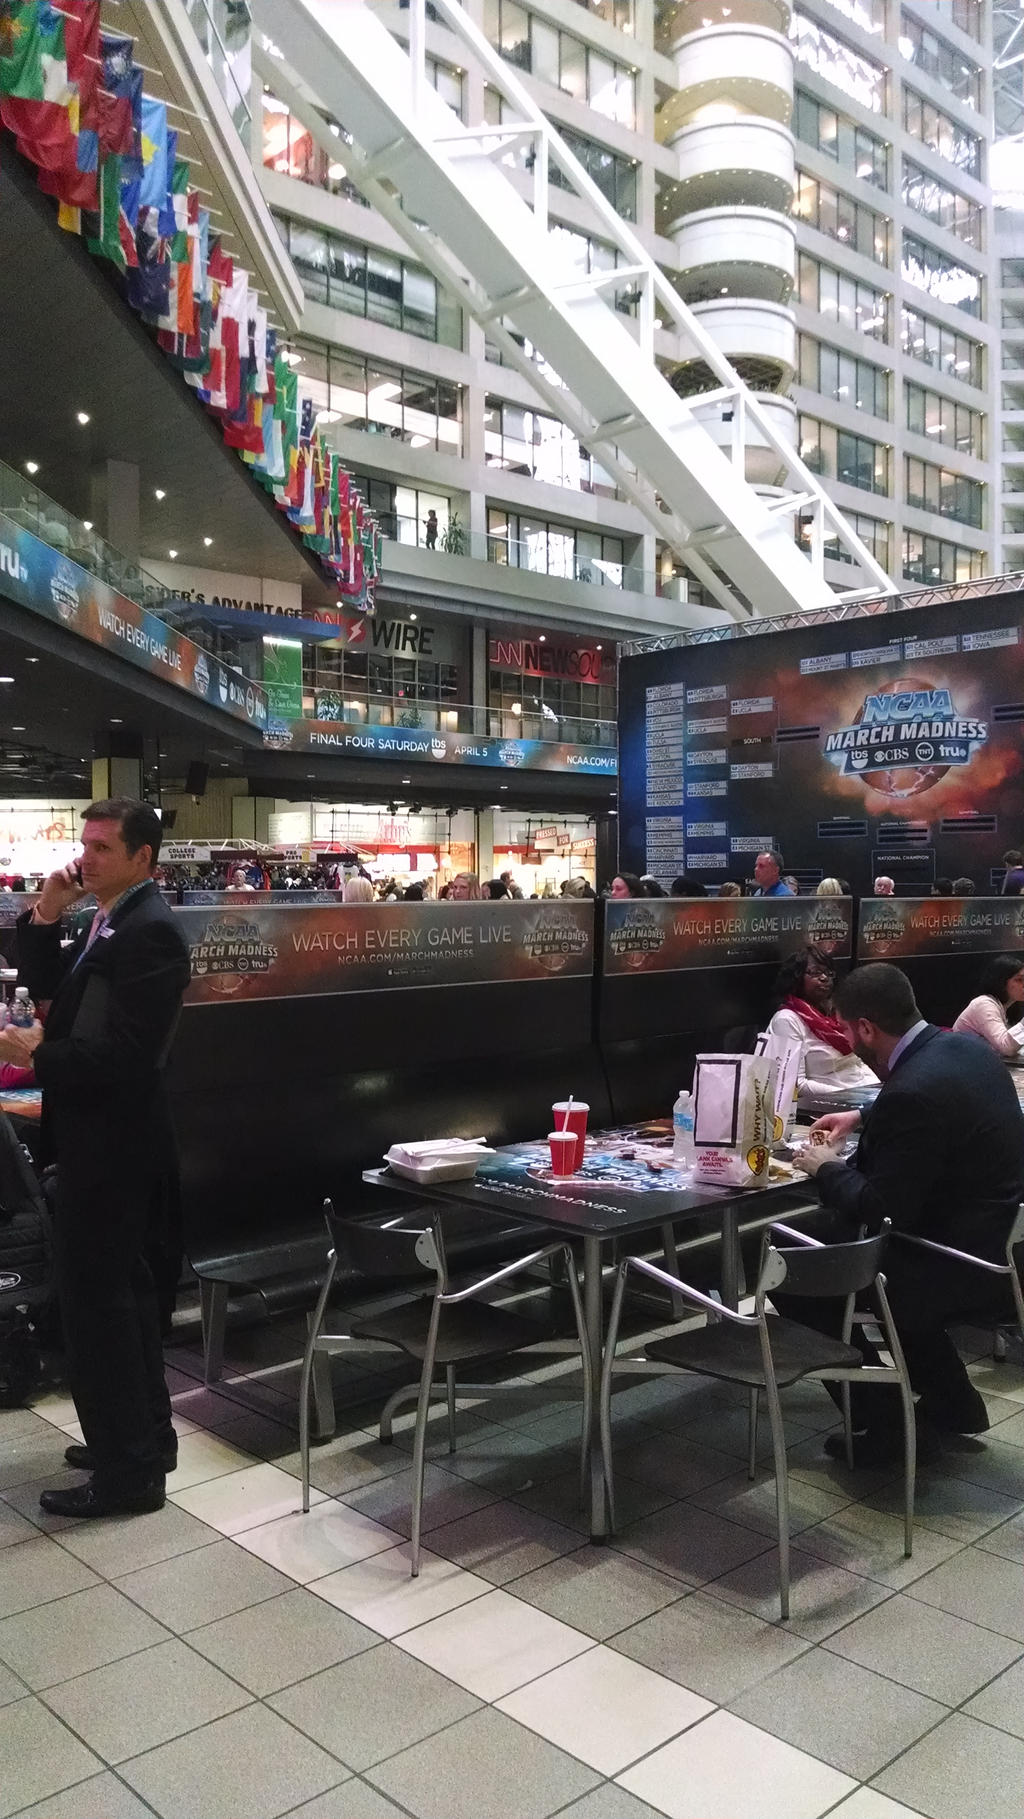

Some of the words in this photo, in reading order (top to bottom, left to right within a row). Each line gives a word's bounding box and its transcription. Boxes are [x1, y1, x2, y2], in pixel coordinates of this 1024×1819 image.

[98, 605, 126, 639] WATCH
[126, 622, 150, 652] EVERY
[149, 638, 168, 664] GAME
[168, 648, 182, 671] LIVE
[371, 617, 435, 655] WIRE
[972, 641, 991, 649] IOWA
[809, 656, 832, 665] ALBANY
[863, 688, 955, 723] NCAA
[743, 737, 762, 745] SOUTH
[826, 725, 895, 751] MARCH
[899, 720, 988, 740] MADNESS
[310, 732, 343, 746] FINAL
[345, 735, 375, 749] FOUR
[378, 738, 429, 753] SATURDAY
[431, 737, 446, 749] tbs
[454, 745, 481, 756] APRIL
[482, 747, 488, 758] 5
[850, 749, 869, 760] tbs
[884, 747, 910, 762] CBS
[559, 836, 569, 845] FOR
[673, 919, 712, 936] WATCH
[714, 918, 748, 934] EVERY
[750, 917, 779, 932] GAME
[781, 916, 802, 931] LIVE
[910, 914, 940, 929] WATCH
[942, 914, 968, 928] EVERY
[970, 913, 993, 927] GAME
[993, 912, 1011, 926] LIVE
[204, 923, 261, 943] NCAA
[292, 931, 359, 953] WATCH
[365, 928, 422, 949] EVERY
[427, 926, 474, 946] GAME
[479, 924, 512, 944] LIVE
[523, 931, 553, 945] MARCH
[555, 929, 589, 943] MADNESS
[609, 929, 637, 942] MARCH
[637, 928, 666, 940] MADNESS
[190, 944, 225, 960] ARCH
[228, 944, 278, 958] MADNESS
[338, 949, 475, 966] NCAA.COM/MARCHMADNESS
[753, 1078, 762, 1114] WAIT?
[753, 1115, 762, 1141] WHY
